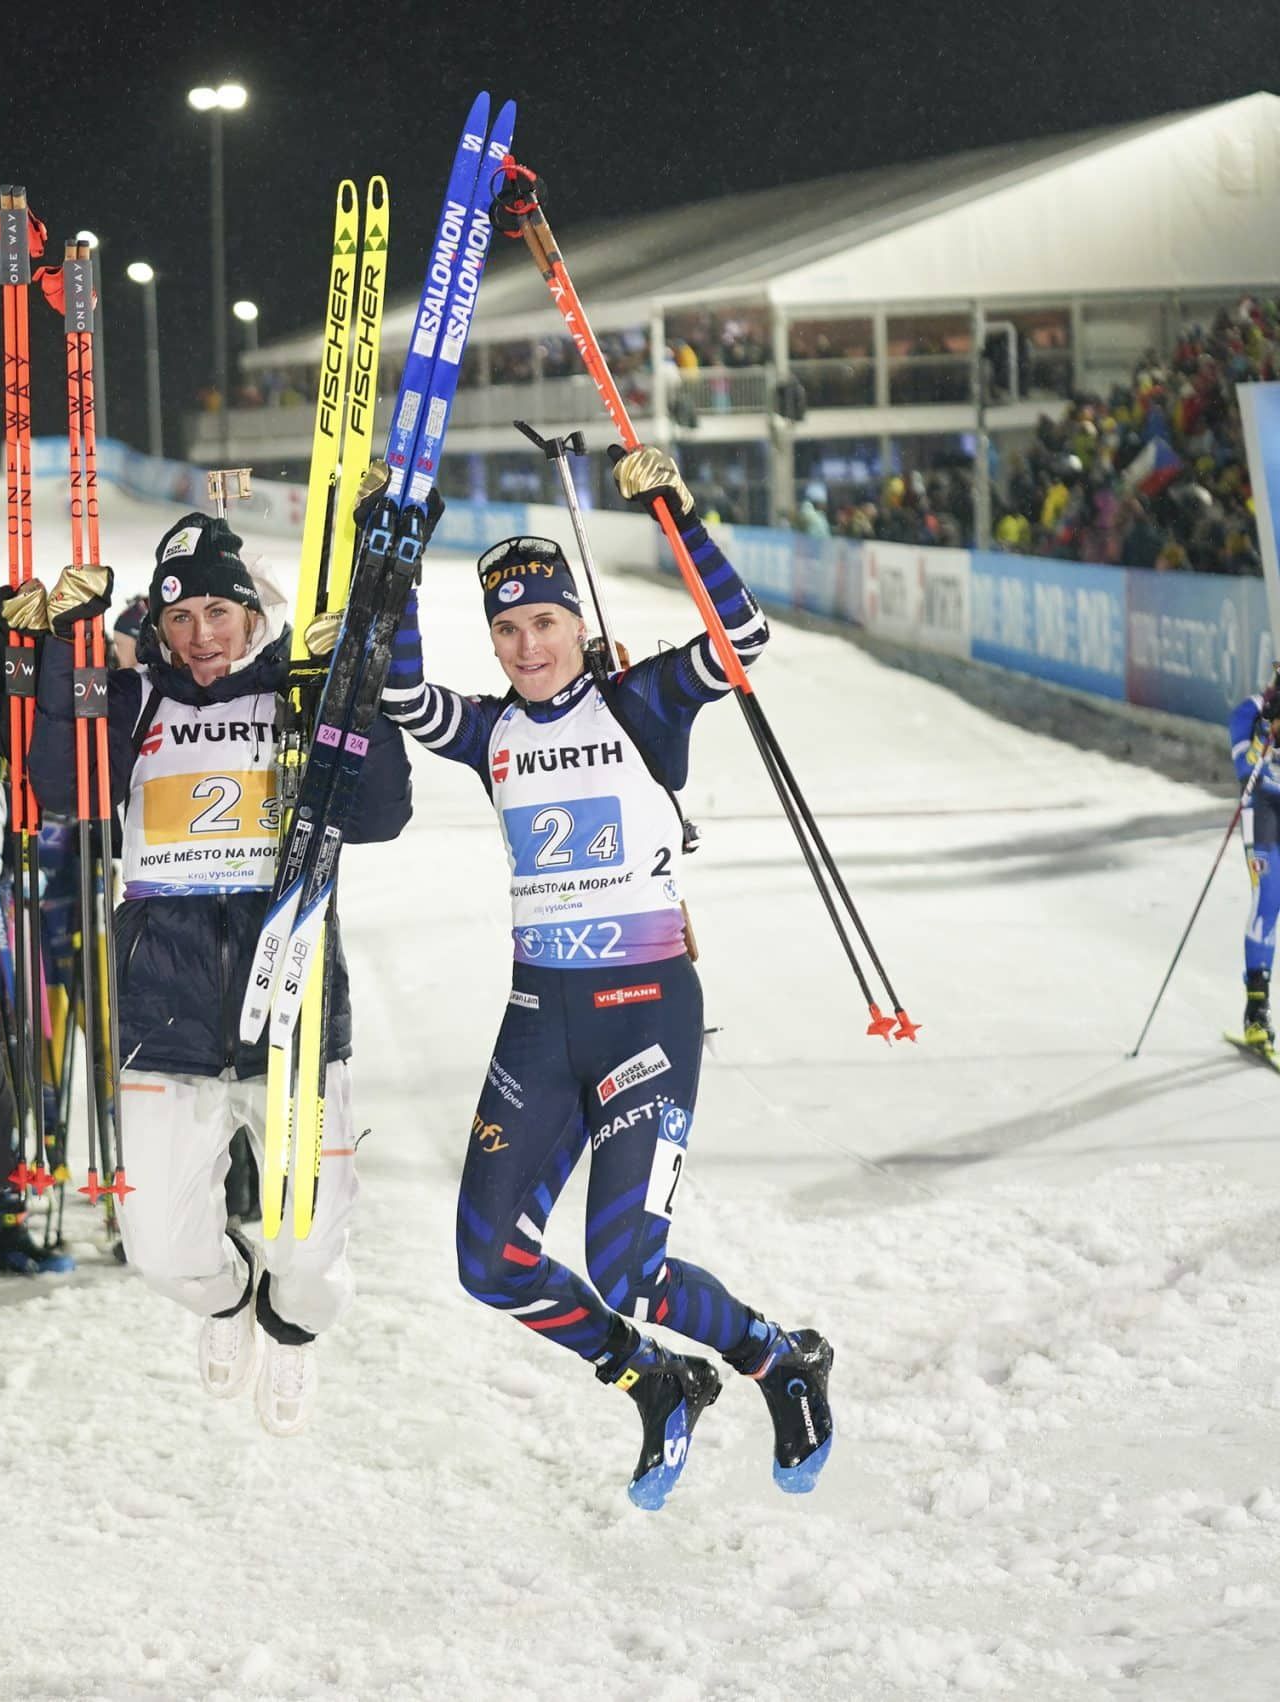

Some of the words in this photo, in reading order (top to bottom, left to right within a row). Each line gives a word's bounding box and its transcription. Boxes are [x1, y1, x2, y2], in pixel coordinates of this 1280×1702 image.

[7, 213, 18, 246] WAY
[8, 252, 19, 284] ONE
[73, 262, 84, 294] WAY
[421, 201, 468, 335] SALOMON
[447, 208, 492, 343] SALOMON
[75, 300, 85, 330] ONE
[320, 267, 350, 437] FISCHER
[351, 264, 381, 436] FISCHER
[487, 561, 554, 590] omfy
[322, 728, 336, 742] 2/4
[351, 737, 364, 751] 2/4
[515, 740, 624, 776] WÜRTH
[189, 776, 242, 835] 2
[532, 806, 574, 869] 2
[588, 823, 619, 861] 4
[140, 851, 171, 866] NOVÉ
[174, 848, 222, 862] MĚSTO
[225, 848, 246, 859] NA
[249, 846, 280, 858] MOR
[651, 845, 673, 878] 2
[556, 921, 627, 960] iX2
[615, 1061, 646, 1082] CAISSE
[618, 1059, 666, 1088] D'EPARGNE
[472, 1111, 510, 1153] mfy
[593, 1102, 655, 1151] CRAFT
[664, 1153, 683, 1215] 2
